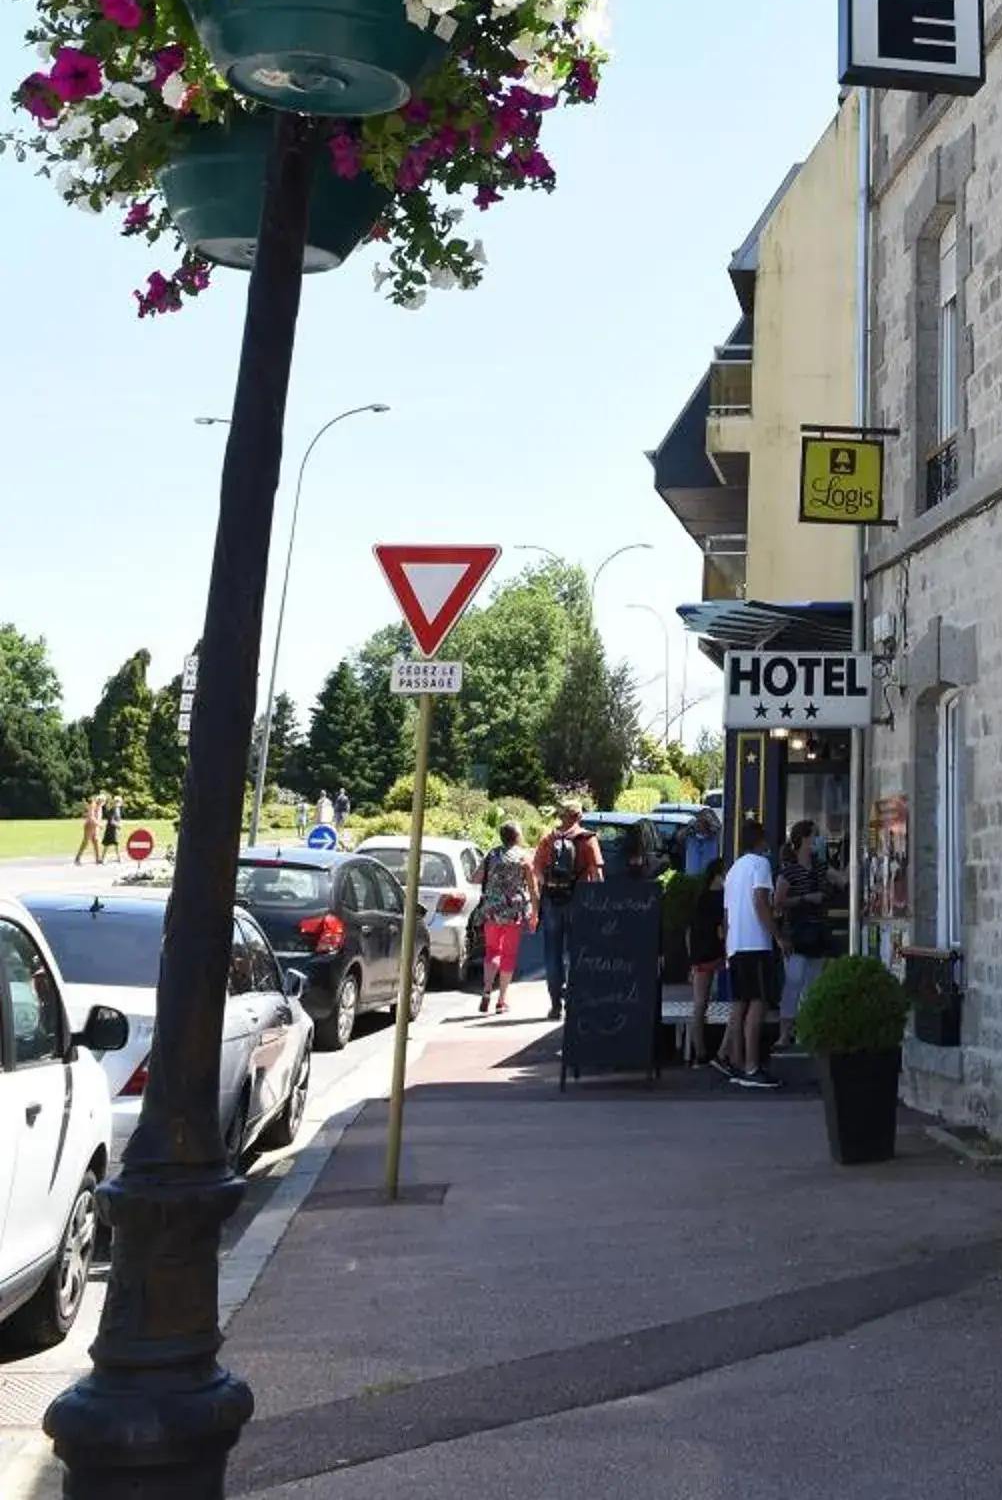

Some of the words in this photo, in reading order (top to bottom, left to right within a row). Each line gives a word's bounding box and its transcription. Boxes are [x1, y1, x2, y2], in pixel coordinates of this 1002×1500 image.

[810, 476, 873, 514] Logis
[399, 678, 453, 688] PASSAGE
[730, 657, 868, 697] HOTEL
